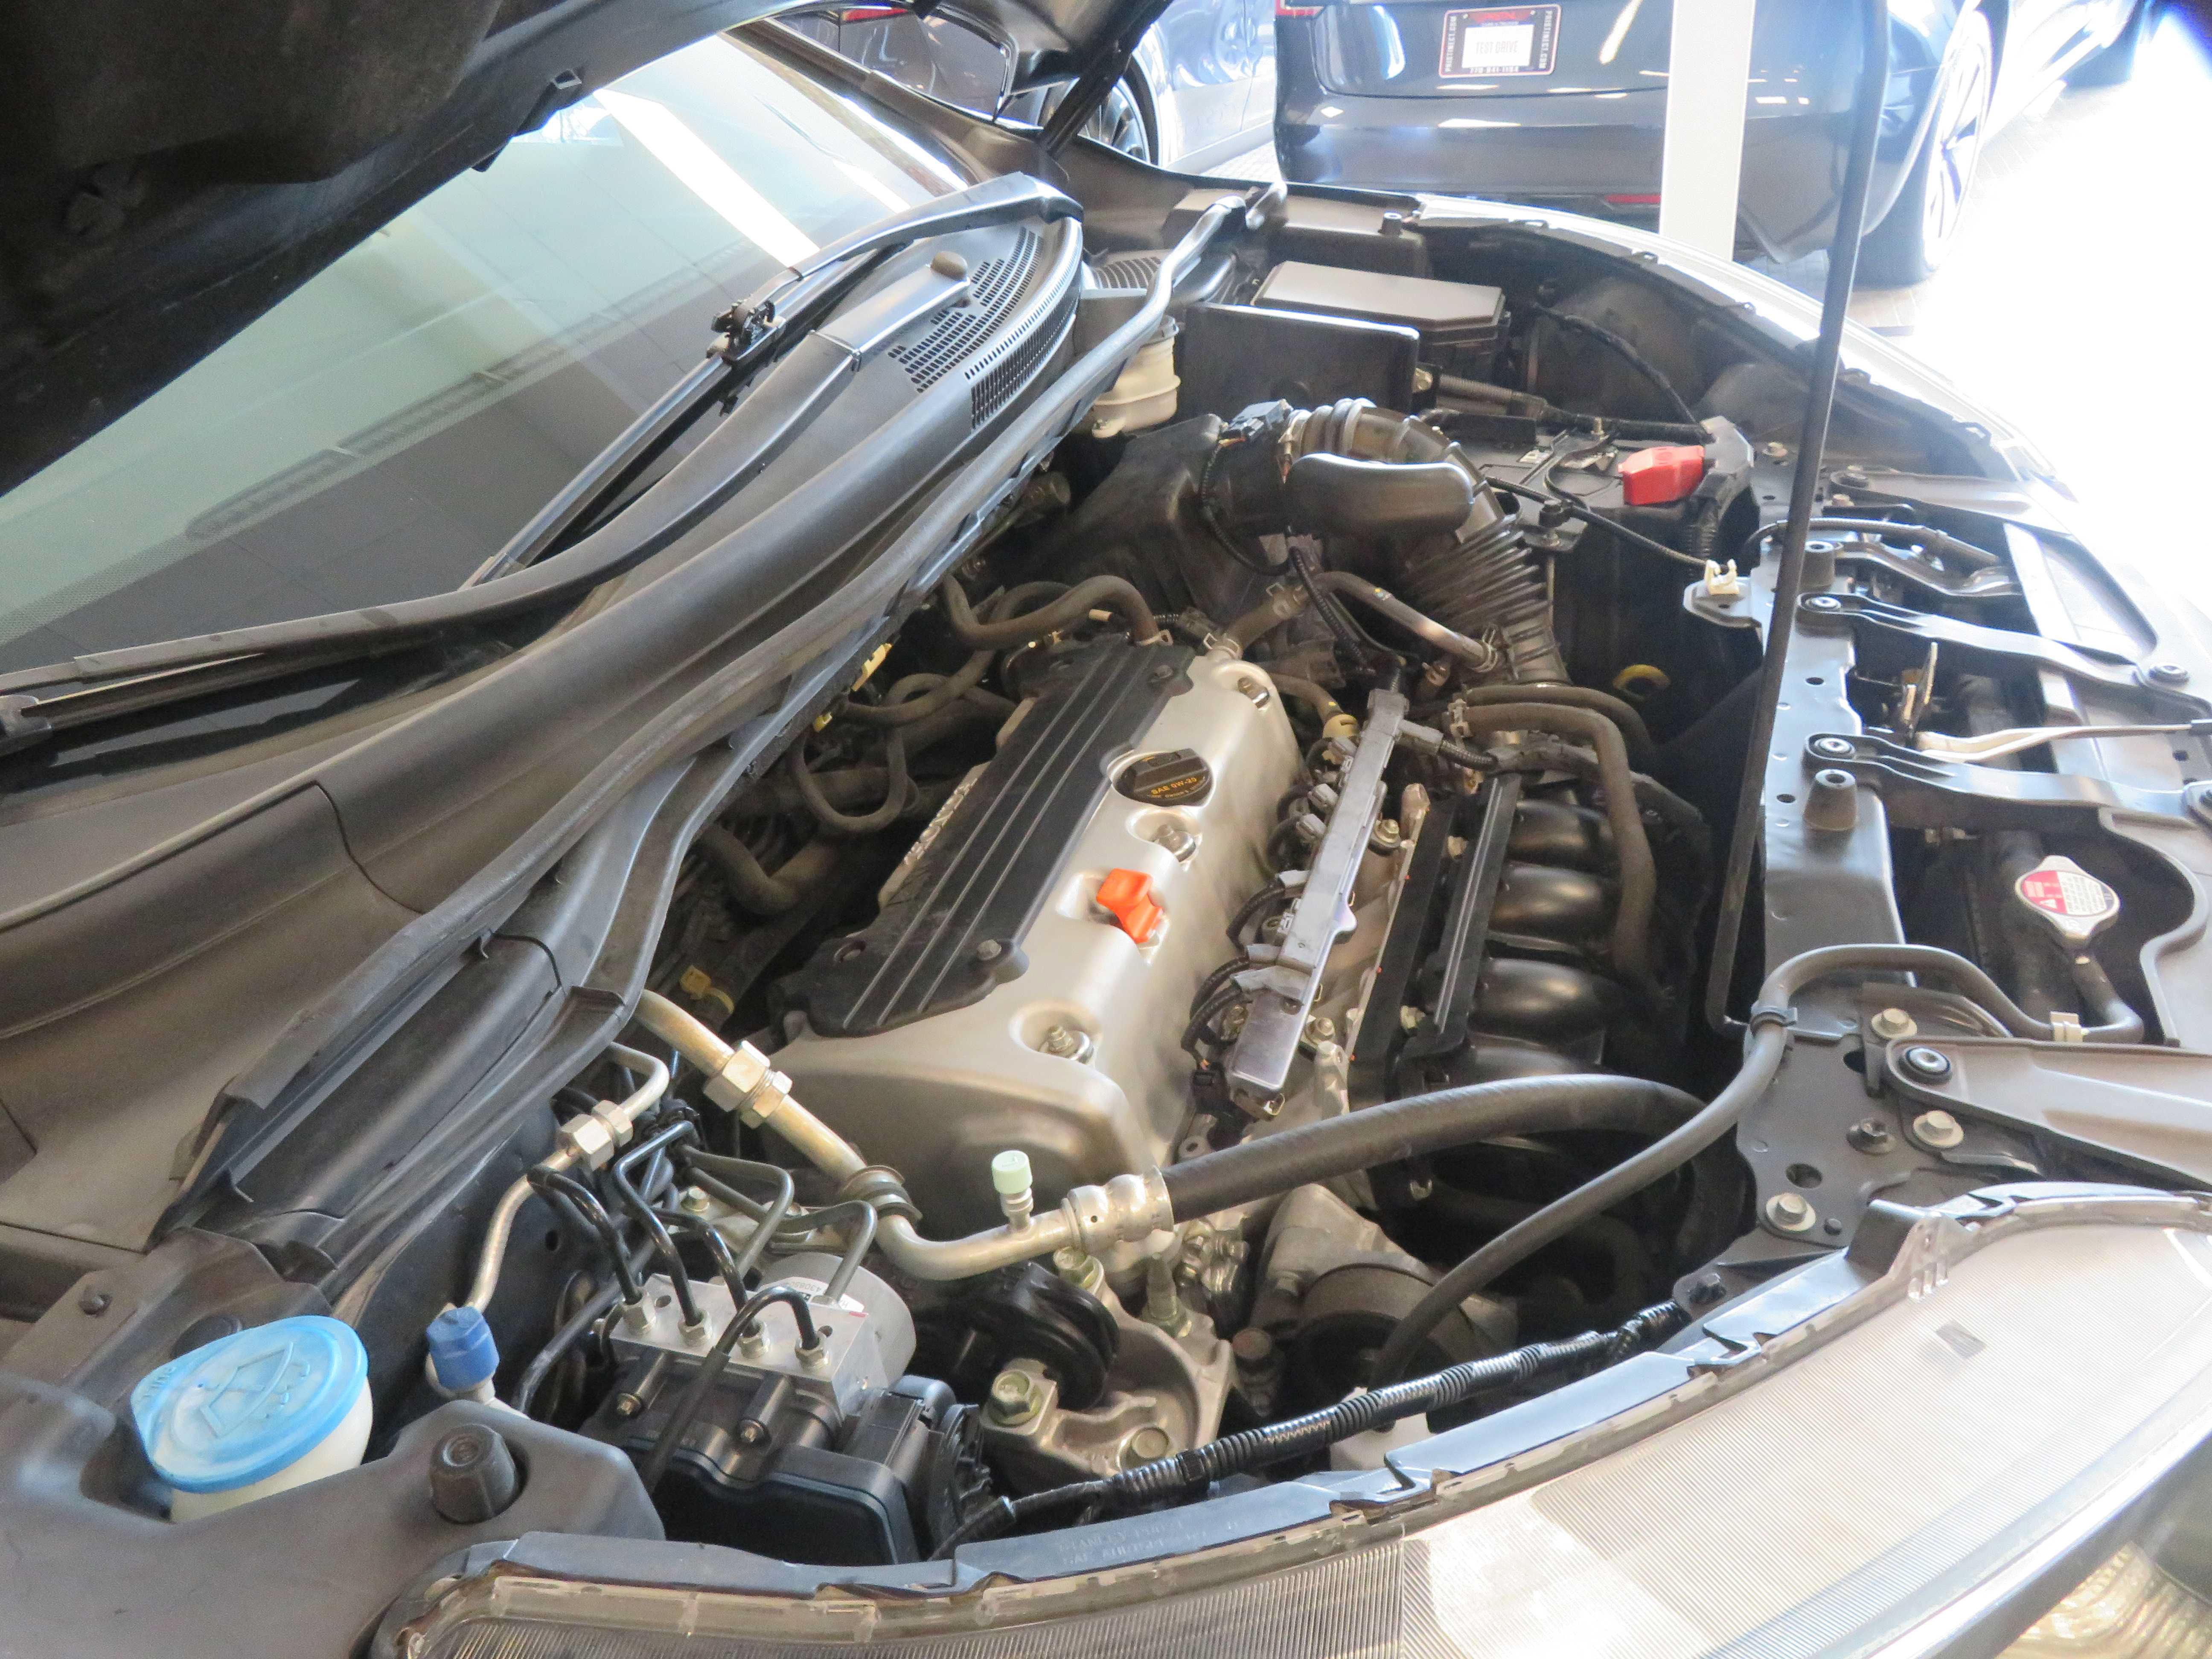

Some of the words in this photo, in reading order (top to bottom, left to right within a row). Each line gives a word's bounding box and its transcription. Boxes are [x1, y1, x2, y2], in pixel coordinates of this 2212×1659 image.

[1476, 41, 1493, 55] TEST
[1495, 40, 1519, 54] DRIVE
[1151, 785, 1170, 795] SAE
[1170, 777, 1197, 789] 0W-20
